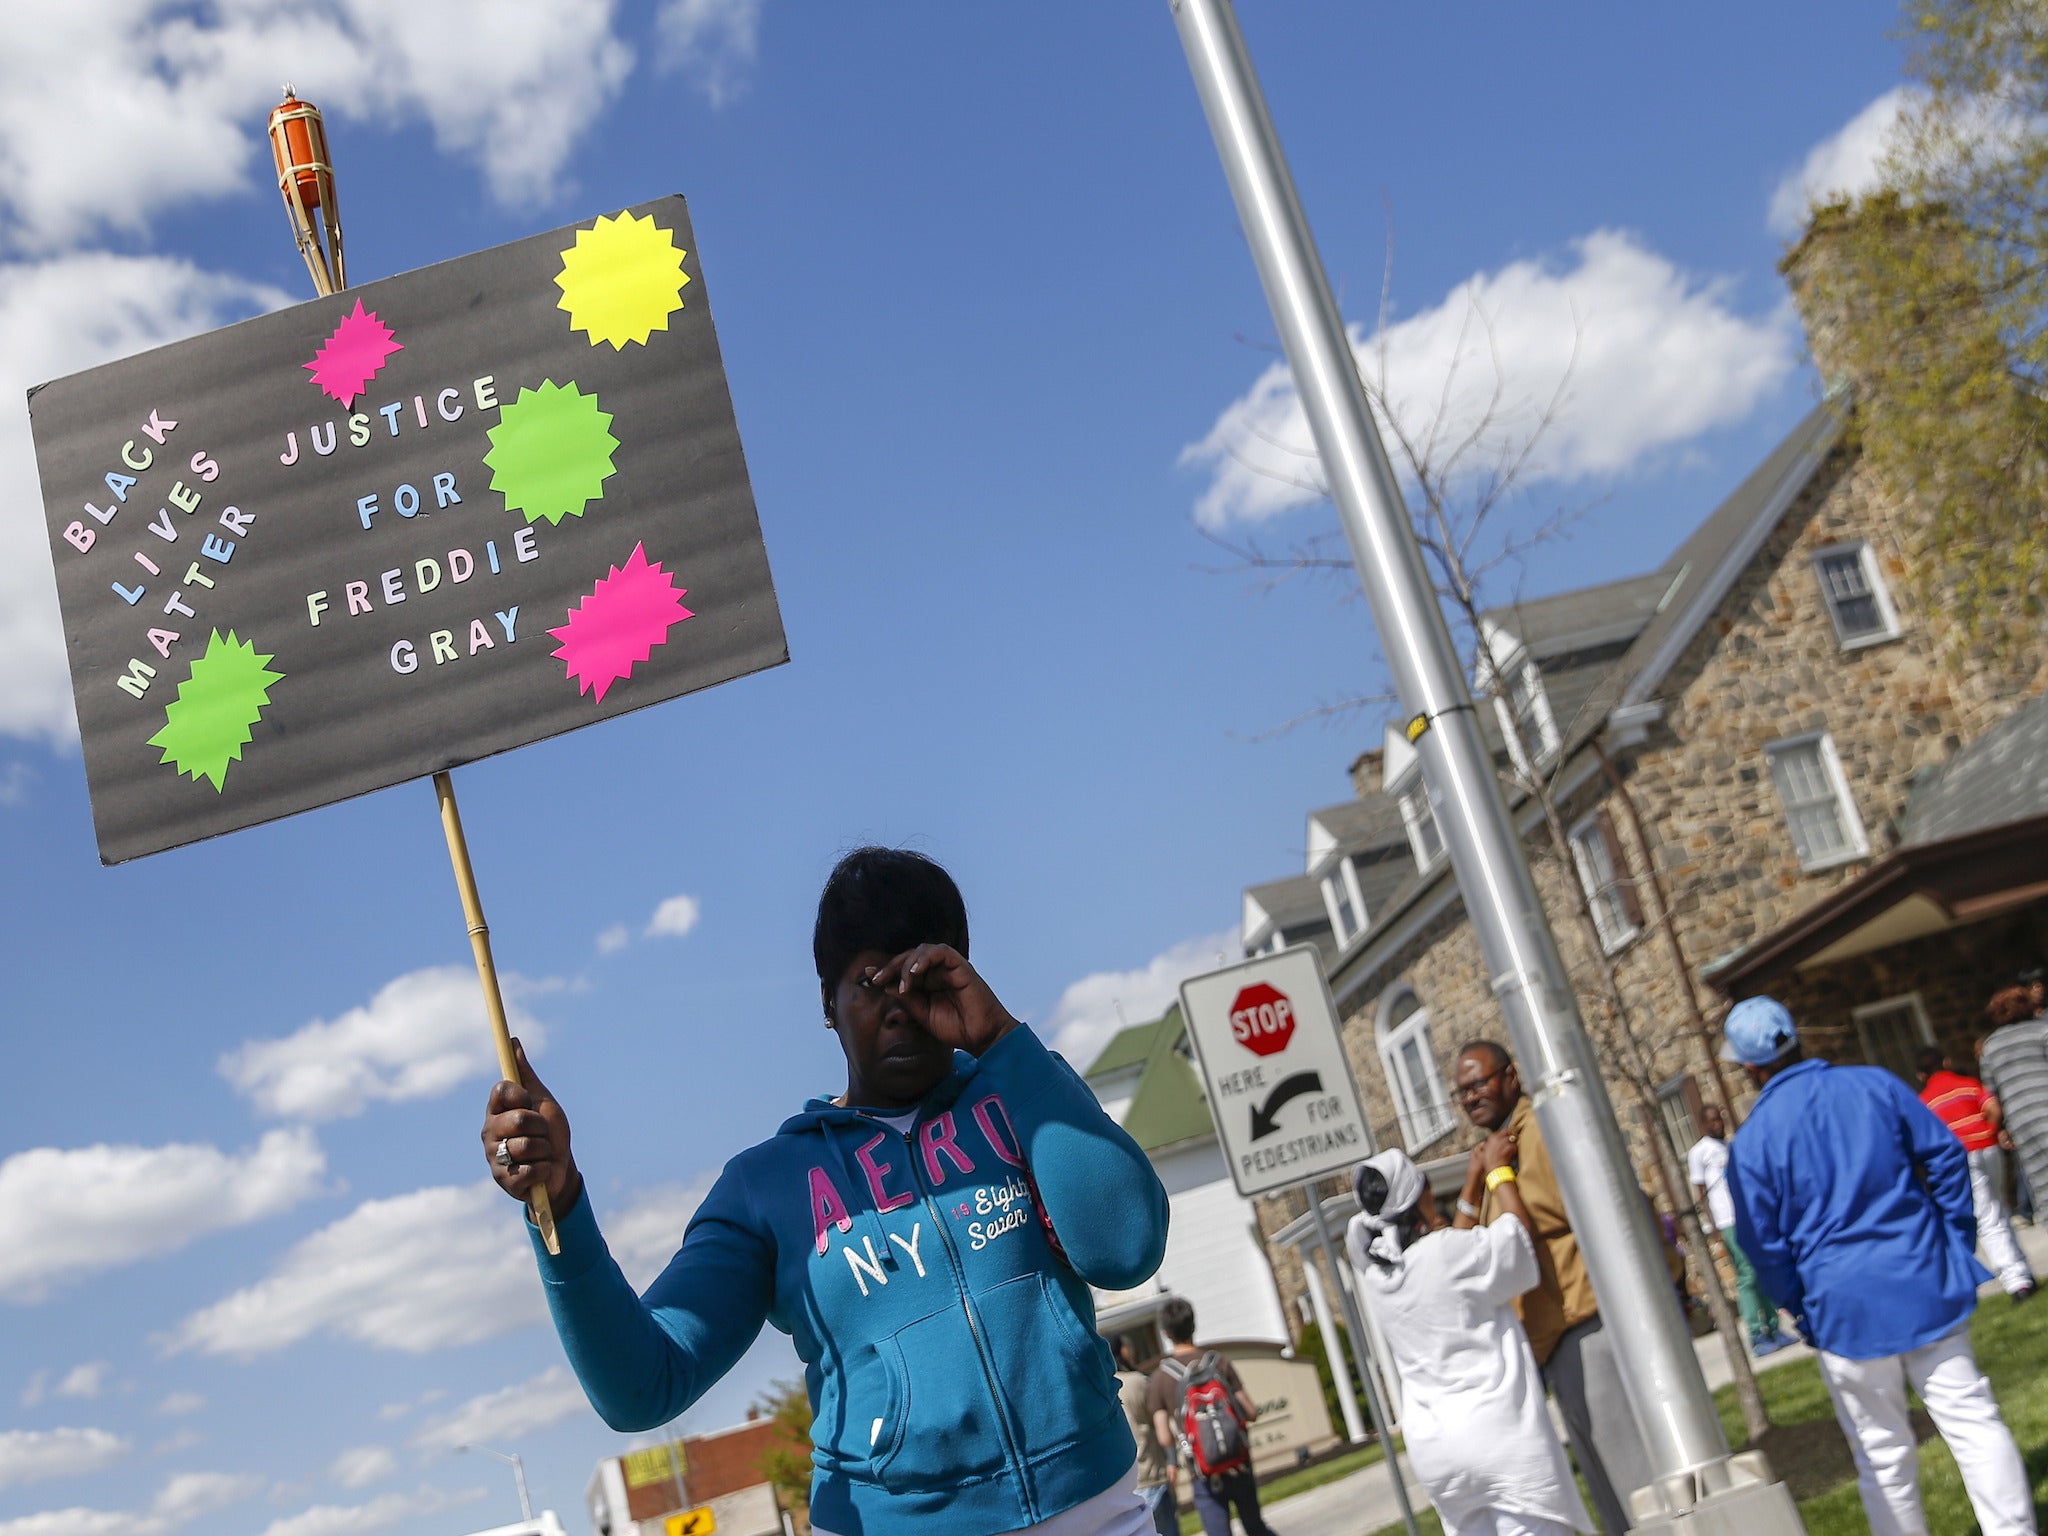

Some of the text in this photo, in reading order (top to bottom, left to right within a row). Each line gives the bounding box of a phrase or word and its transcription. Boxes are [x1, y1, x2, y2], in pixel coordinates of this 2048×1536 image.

[280, 375, 498, 466] JUSTICE
[62, 408, 178, 554] BLACK
[356, 471, 463, 530] FOR
[111, 450, 220, 606] LIVES
[117, 505, 256, 700] MATTER
[306, 526, 539, 627] FREDDIE
[390, 605, 519, 674] GRAY
[1231, 998, 1291, 1042] STOP
[1218, 1066, 1267, 1098] HERE
[1306, 1095, 1345, 1124] FOR
[808, 1093, 1028, 1257] AERO
[1240, 1123, 1358, 1177] PEDESTRIANS
[951, 1202, 971, 1221] 19
[967, 1208, 1028, 1250] Seven
[843, 1222, 926, 1297] NY
